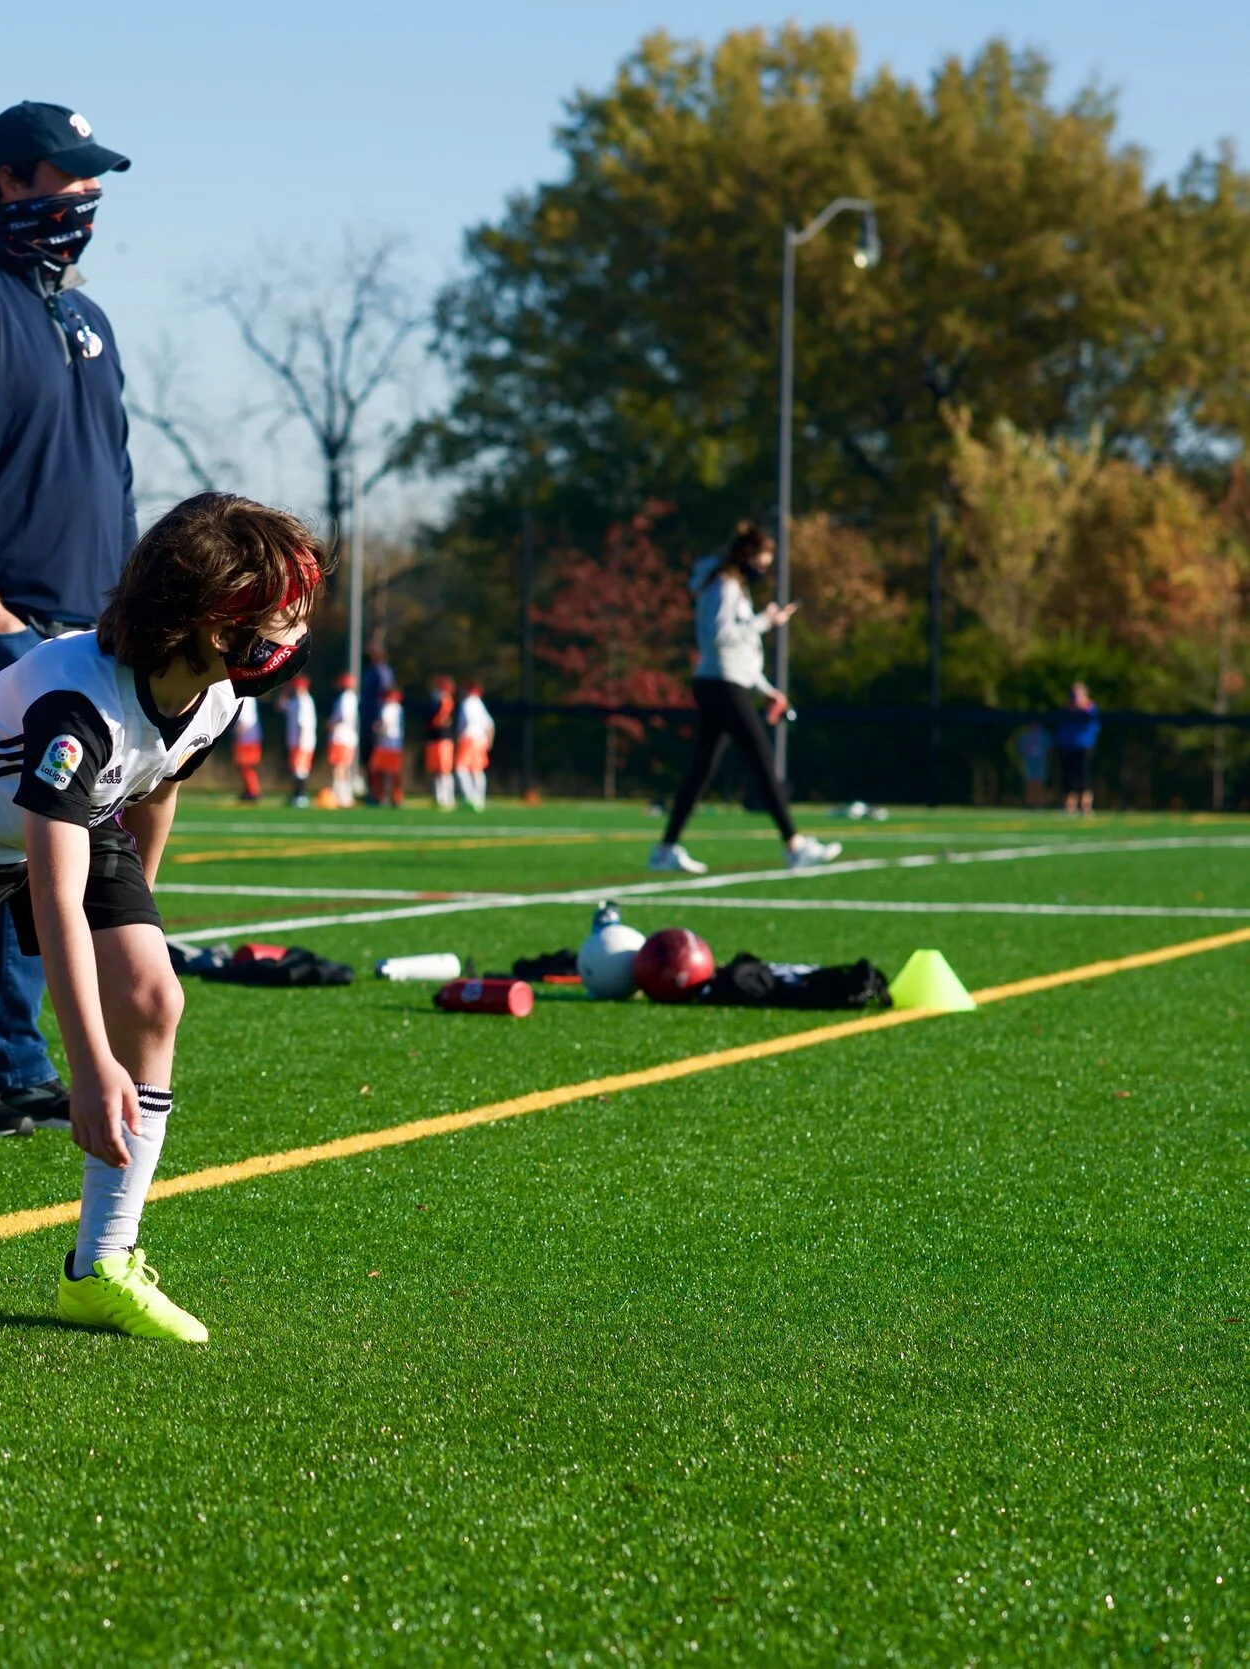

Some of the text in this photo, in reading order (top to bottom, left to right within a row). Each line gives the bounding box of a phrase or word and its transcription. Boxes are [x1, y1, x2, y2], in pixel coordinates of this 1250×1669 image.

[49, 230, 83, 245] TEXAS
[242, 647, 292, 677] Supreme
[41, 765, 67, 783] LaLiga
